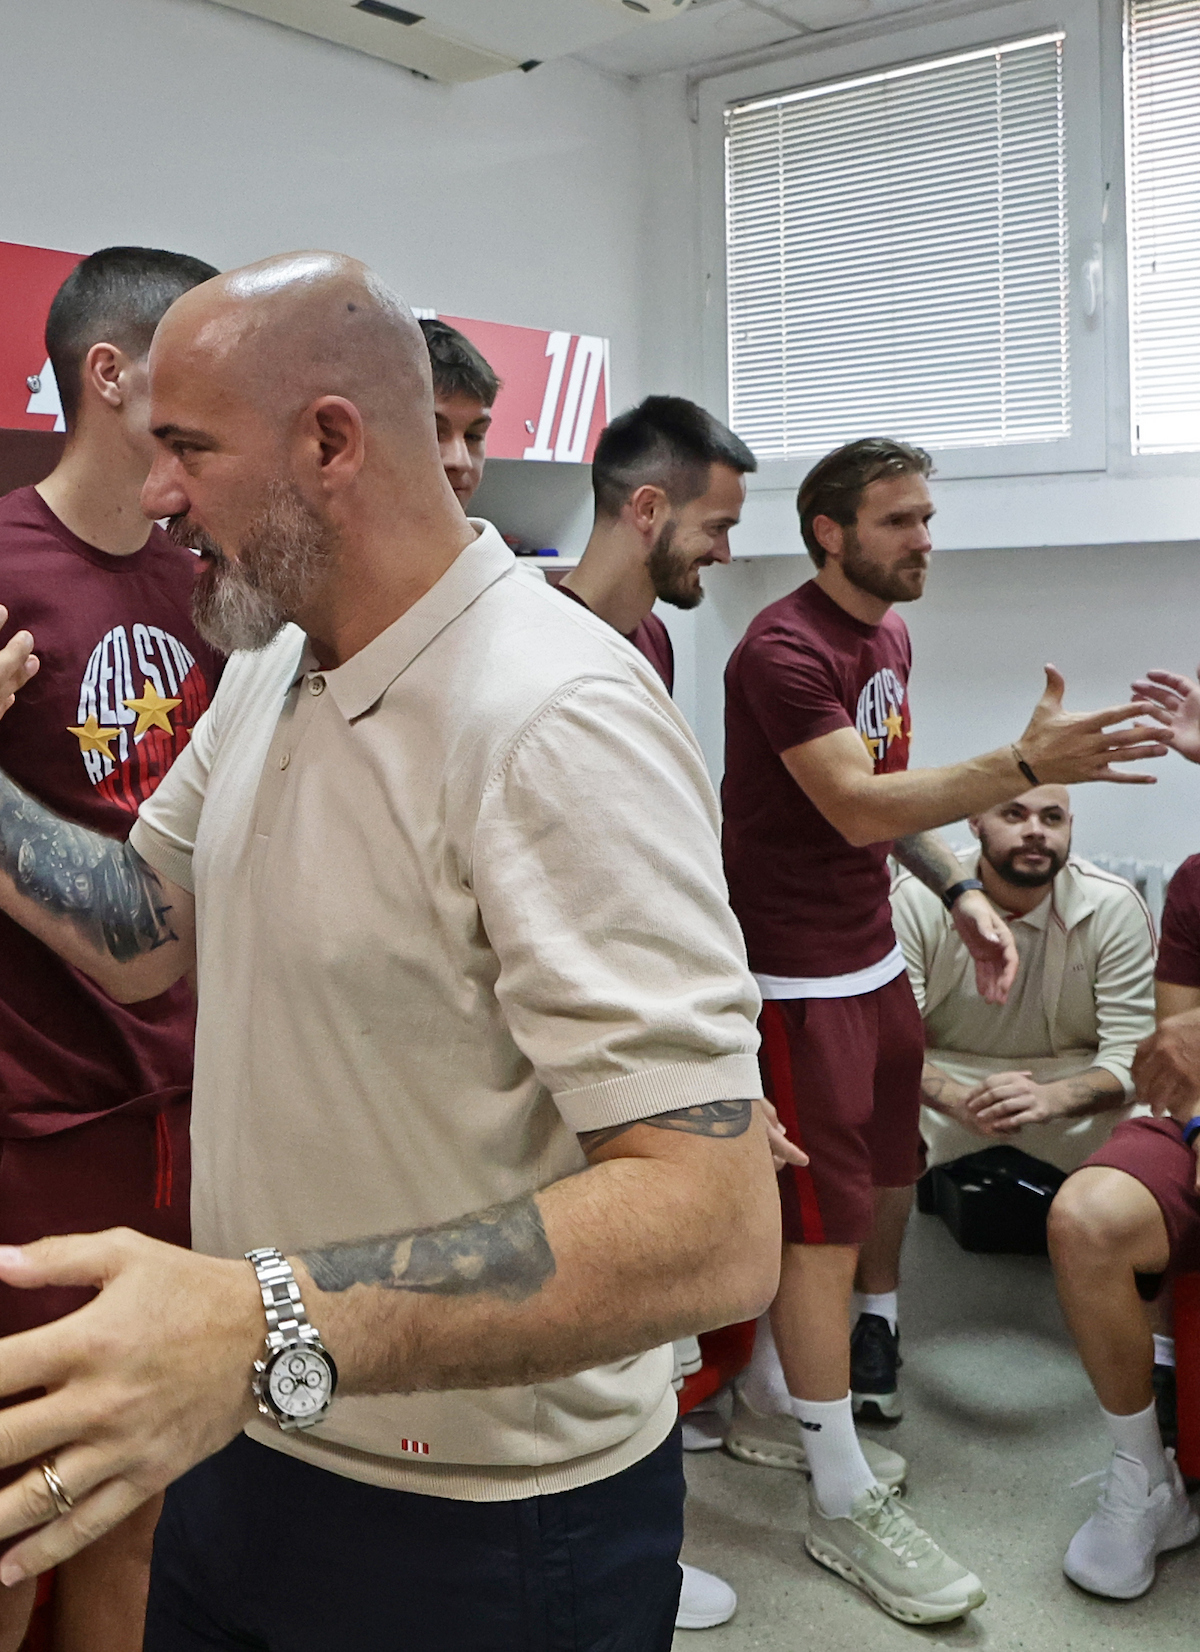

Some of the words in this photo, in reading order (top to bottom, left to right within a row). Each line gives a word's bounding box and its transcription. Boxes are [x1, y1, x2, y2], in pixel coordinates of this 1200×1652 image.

[522, 330, 604, 463] 10
[77, 625, 136, 725] RED
[133, 623, 209, 725] STAR
[856, 671, 888, 738] RED
